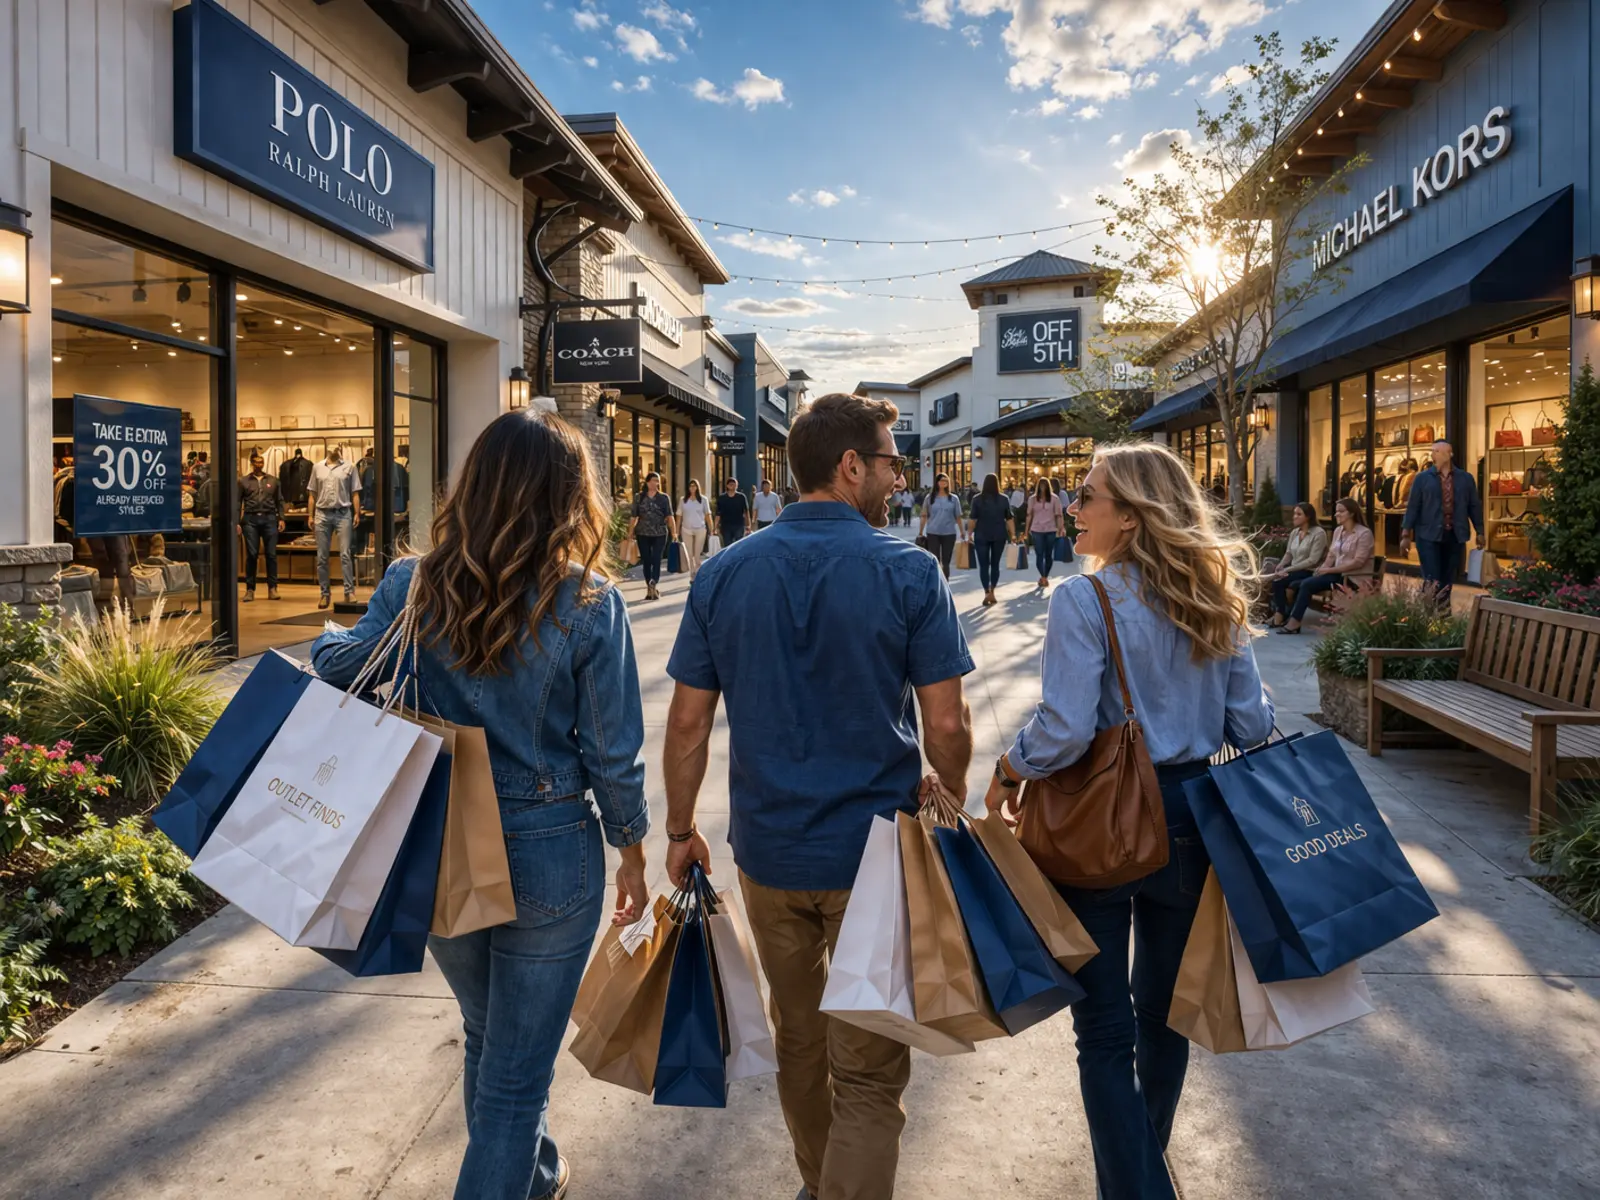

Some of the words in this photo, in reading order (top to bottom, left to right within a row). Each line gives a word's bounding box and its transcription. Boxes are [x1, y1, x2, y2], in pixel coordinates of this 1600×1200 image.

[270, 70, 393, 196] POLO
[268, 140, 329, 192] RALPH
[336, 181, 395, 230] LAUREN
[1312, 185, 1405, 272] MICHAEL
[1412, 106, 1512, 207] KORS
[1032, 319, 1073, 342] OFF
[557, 347, 635, 360] COACH
[1033, 340, 1073, 363] 5TH
[92, 422, 122, 441] TAKE
[92, 444, 166, 490] 30%
[143, 478, 167, 490] OFF
[267, 777, 313, 810] OUTLET
[308, 800, 346, 829] FINDS
[1285, 838, 1327, 864] GOOD
[1324, 823, 1368, 849] DEALS
